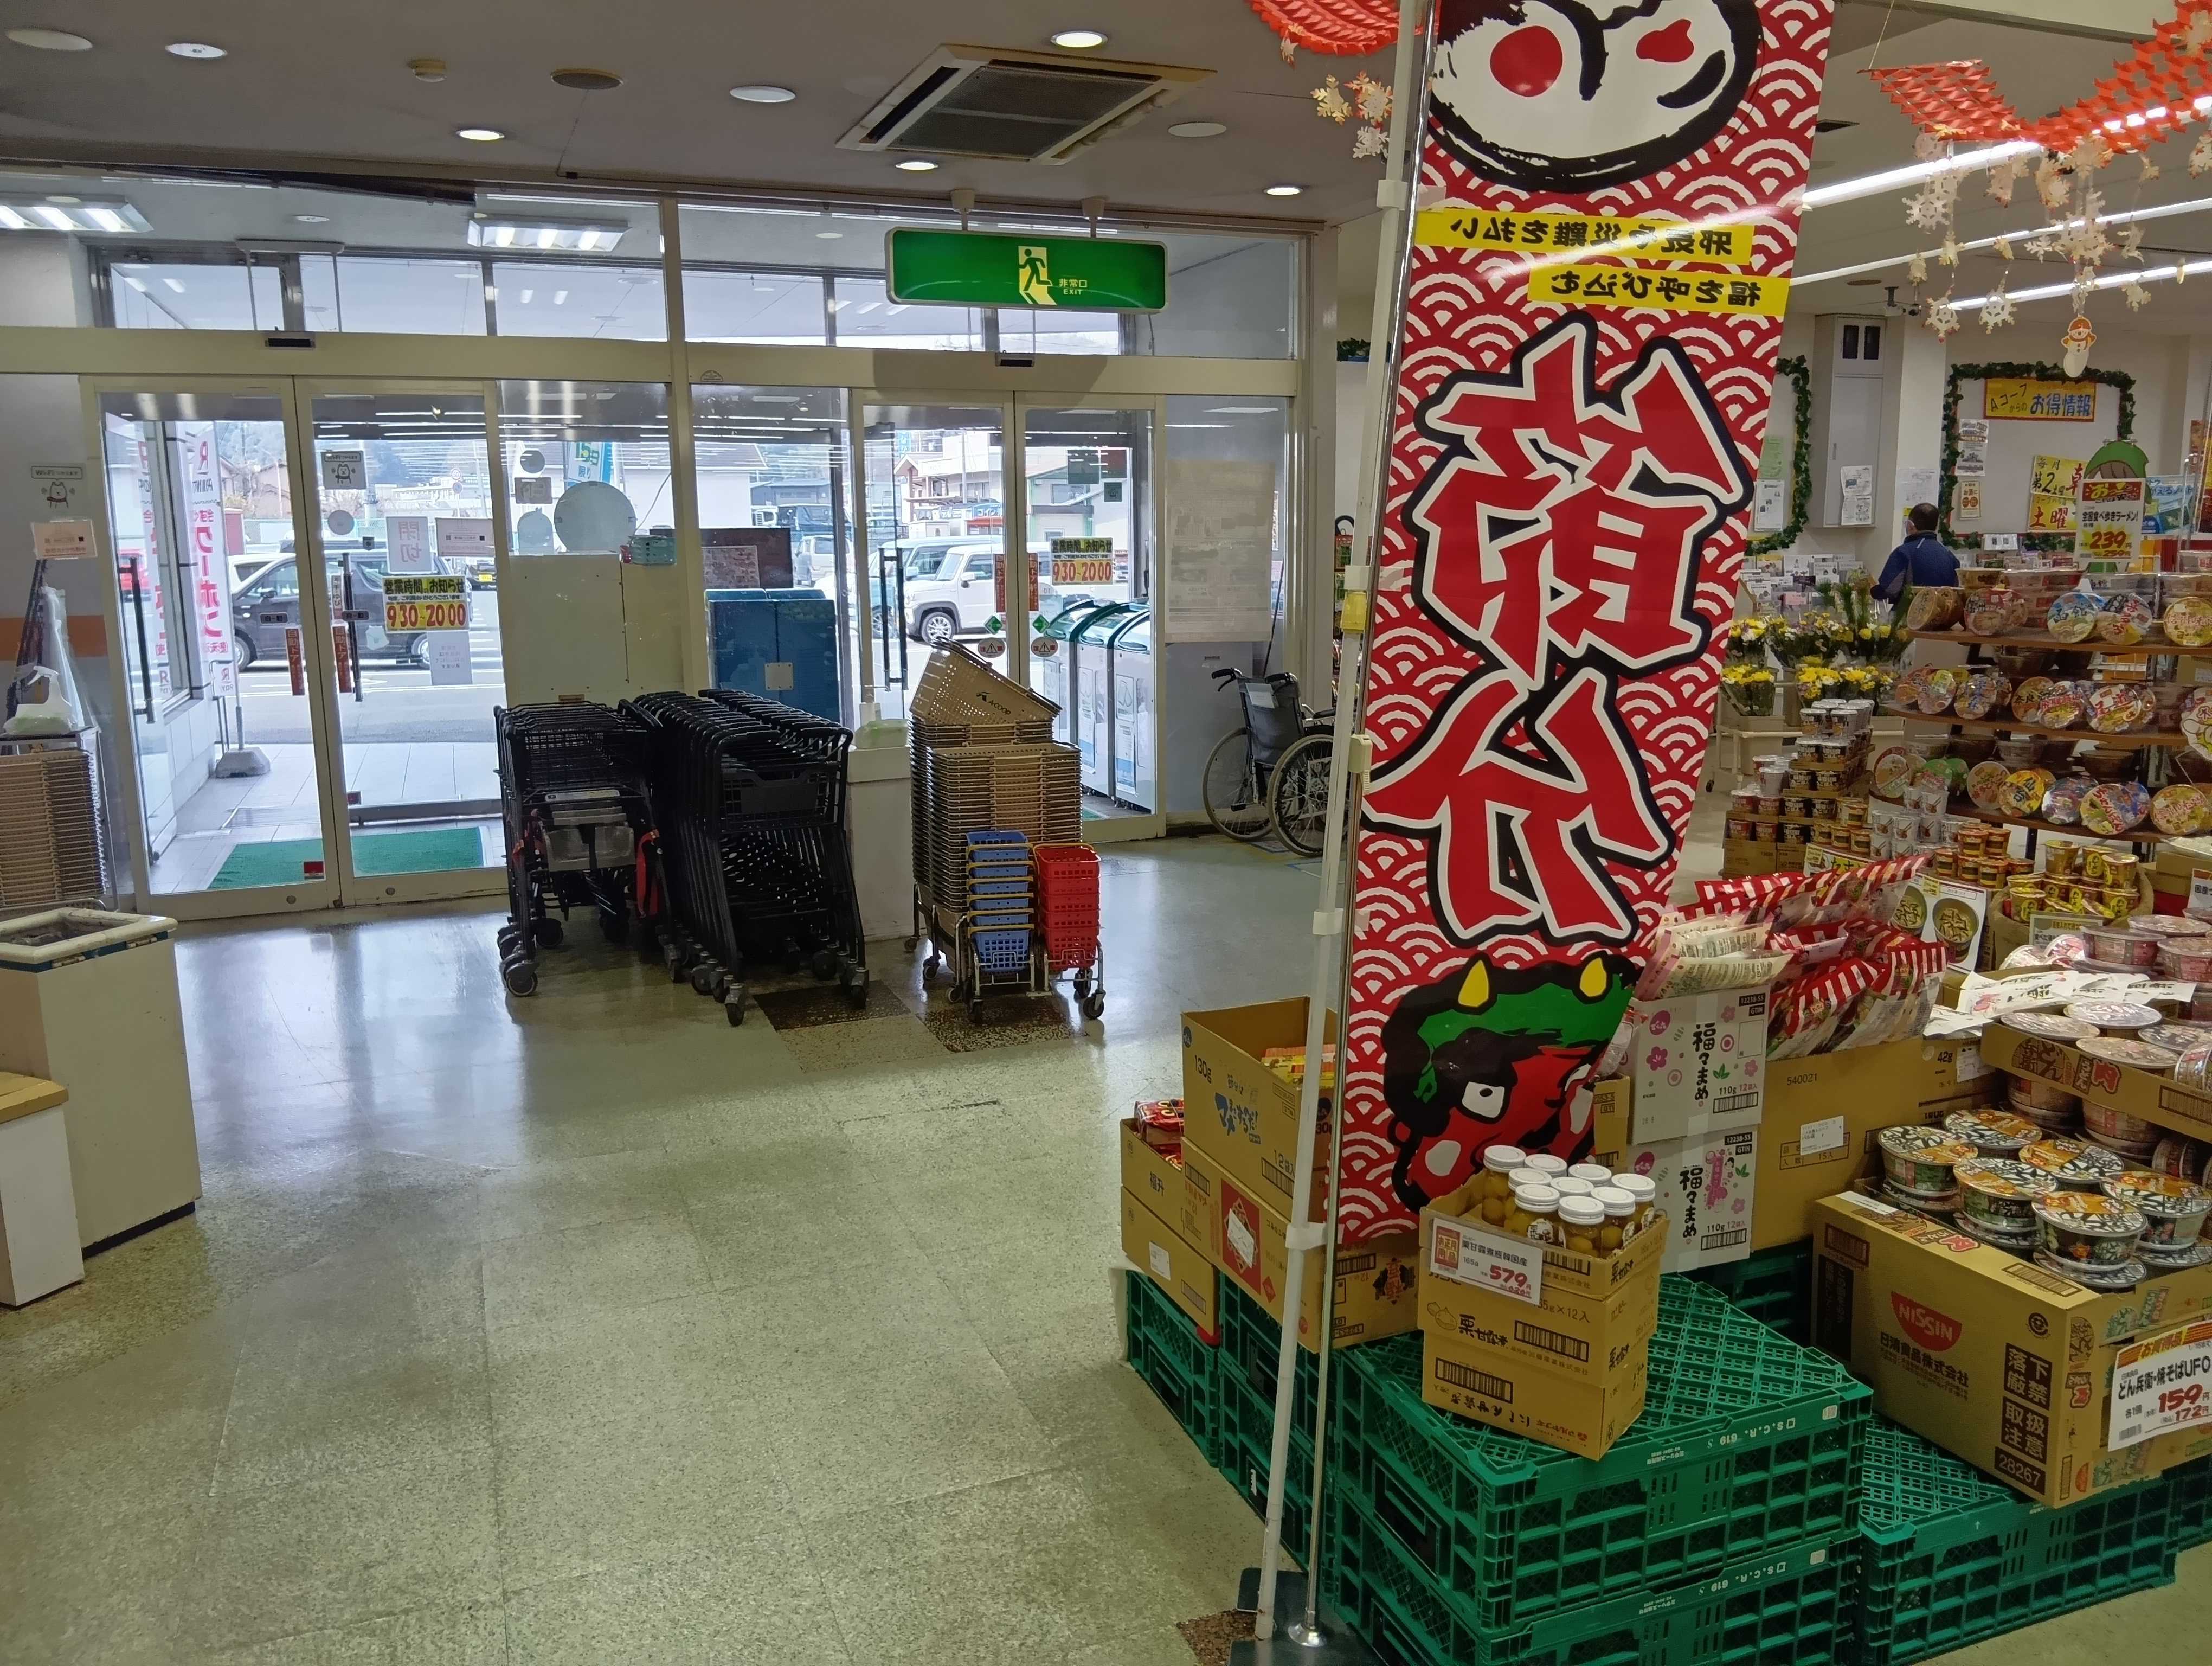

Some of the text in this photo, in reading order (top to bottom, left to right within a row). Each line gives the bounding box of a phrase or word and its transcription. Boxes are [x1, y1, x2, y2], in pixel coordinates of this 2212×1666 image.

[1059, 278, 1088, 288] 非常口
[2030, 393, 2091, 416] お得情報
[2089, 530, 2126, 549] 239
[384, 579, 465, 594] 営業時間のお知らせ
[1750, 1007, 1764, 1016] GTIN
[1692, 1022, 1716, 1101] 福々まめ
[1937, 1050, 1953, 1063] 42g
[1194, 1055, 1212, 1084] 130g
[1786, 1073, 1818, 1086] 540021
[1719, 1086, 1737, 1095] 110g
[1737, 1145, 1751, 1154] GTIN
[1679, 1164, 1703, 1239] 福々まめ
[1707, 1222, 1725, 1233] 110g
[1489, 1264, 1527, 1288] 579
[1508, 1285, 1526, 1296] 626
[1898, 1302, 1953, 1342] NISSIN
[1880, 1331, 1969, 1388] 日清食品株式会社
[2008, 1348, 2049, 1380] 落下
[2007, 1370, 2048, 1406] 厳禁
[2158, 1383, 2210, 1413] 159 円
[2005, 1401, 2046, 1437] 取扱
[2175, 1405, 2202, 1421] 172
[2004, 1426, 2044, 1460] 注意
[1998, 1453, 2042, 1487] 28267
